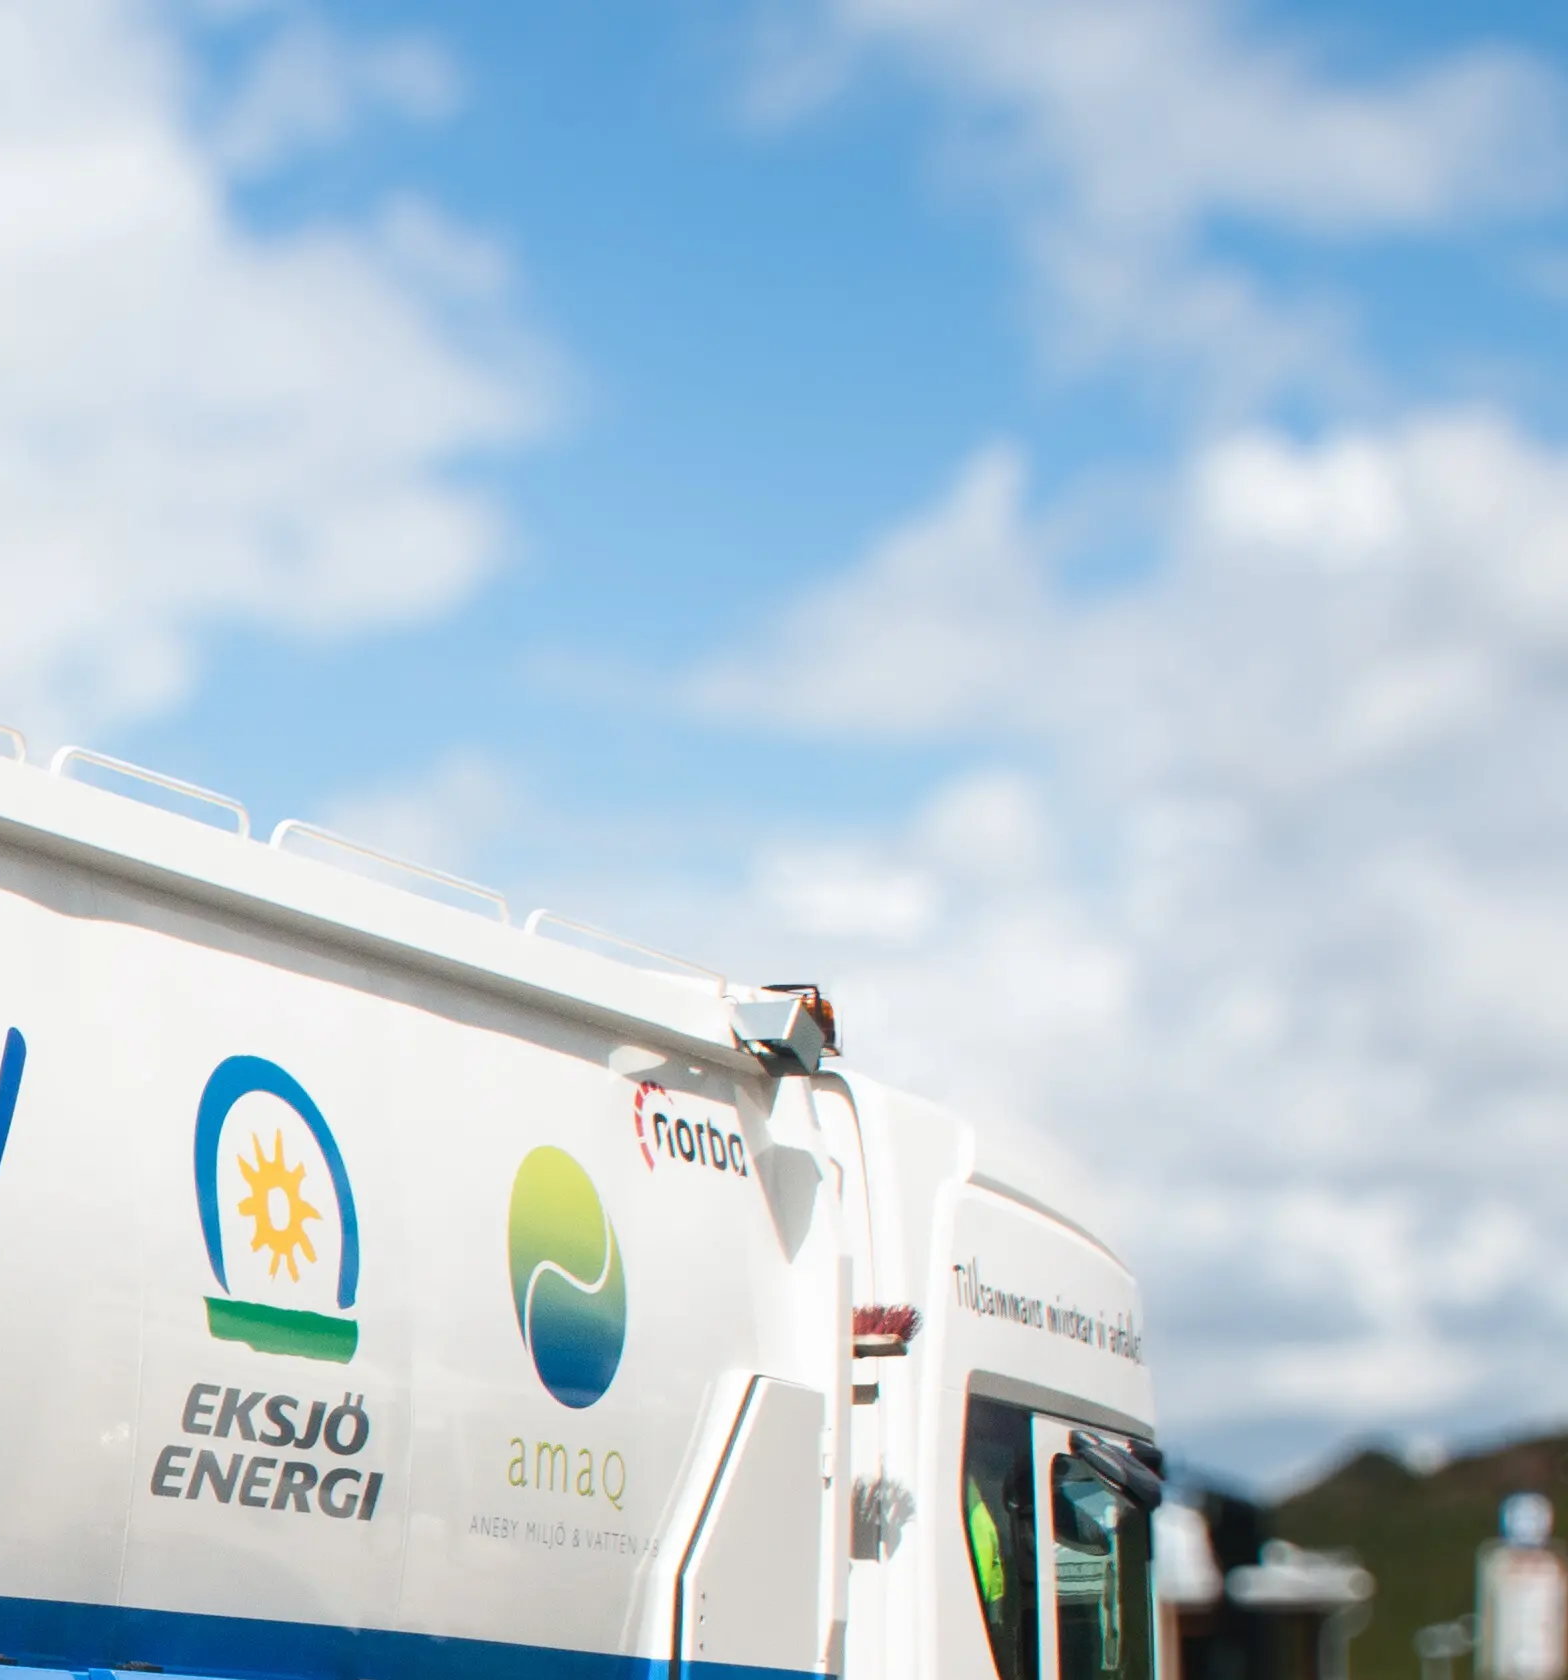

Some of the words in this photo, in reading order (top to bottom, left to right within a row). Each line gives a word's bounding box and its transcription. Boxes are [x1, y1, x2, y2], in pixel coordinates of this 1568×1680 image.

[653, 1112, 748, 1178] norba
[181, 1383, 370, 1456] EKSJÖ
[150, 1445, 384, 1521] ENERGI
[469, 1515, 519, 1539] ANEBY
[526, 1521, 566, 1550] MILJÖ
[585, 1531, 638, 1555] VATTEN
